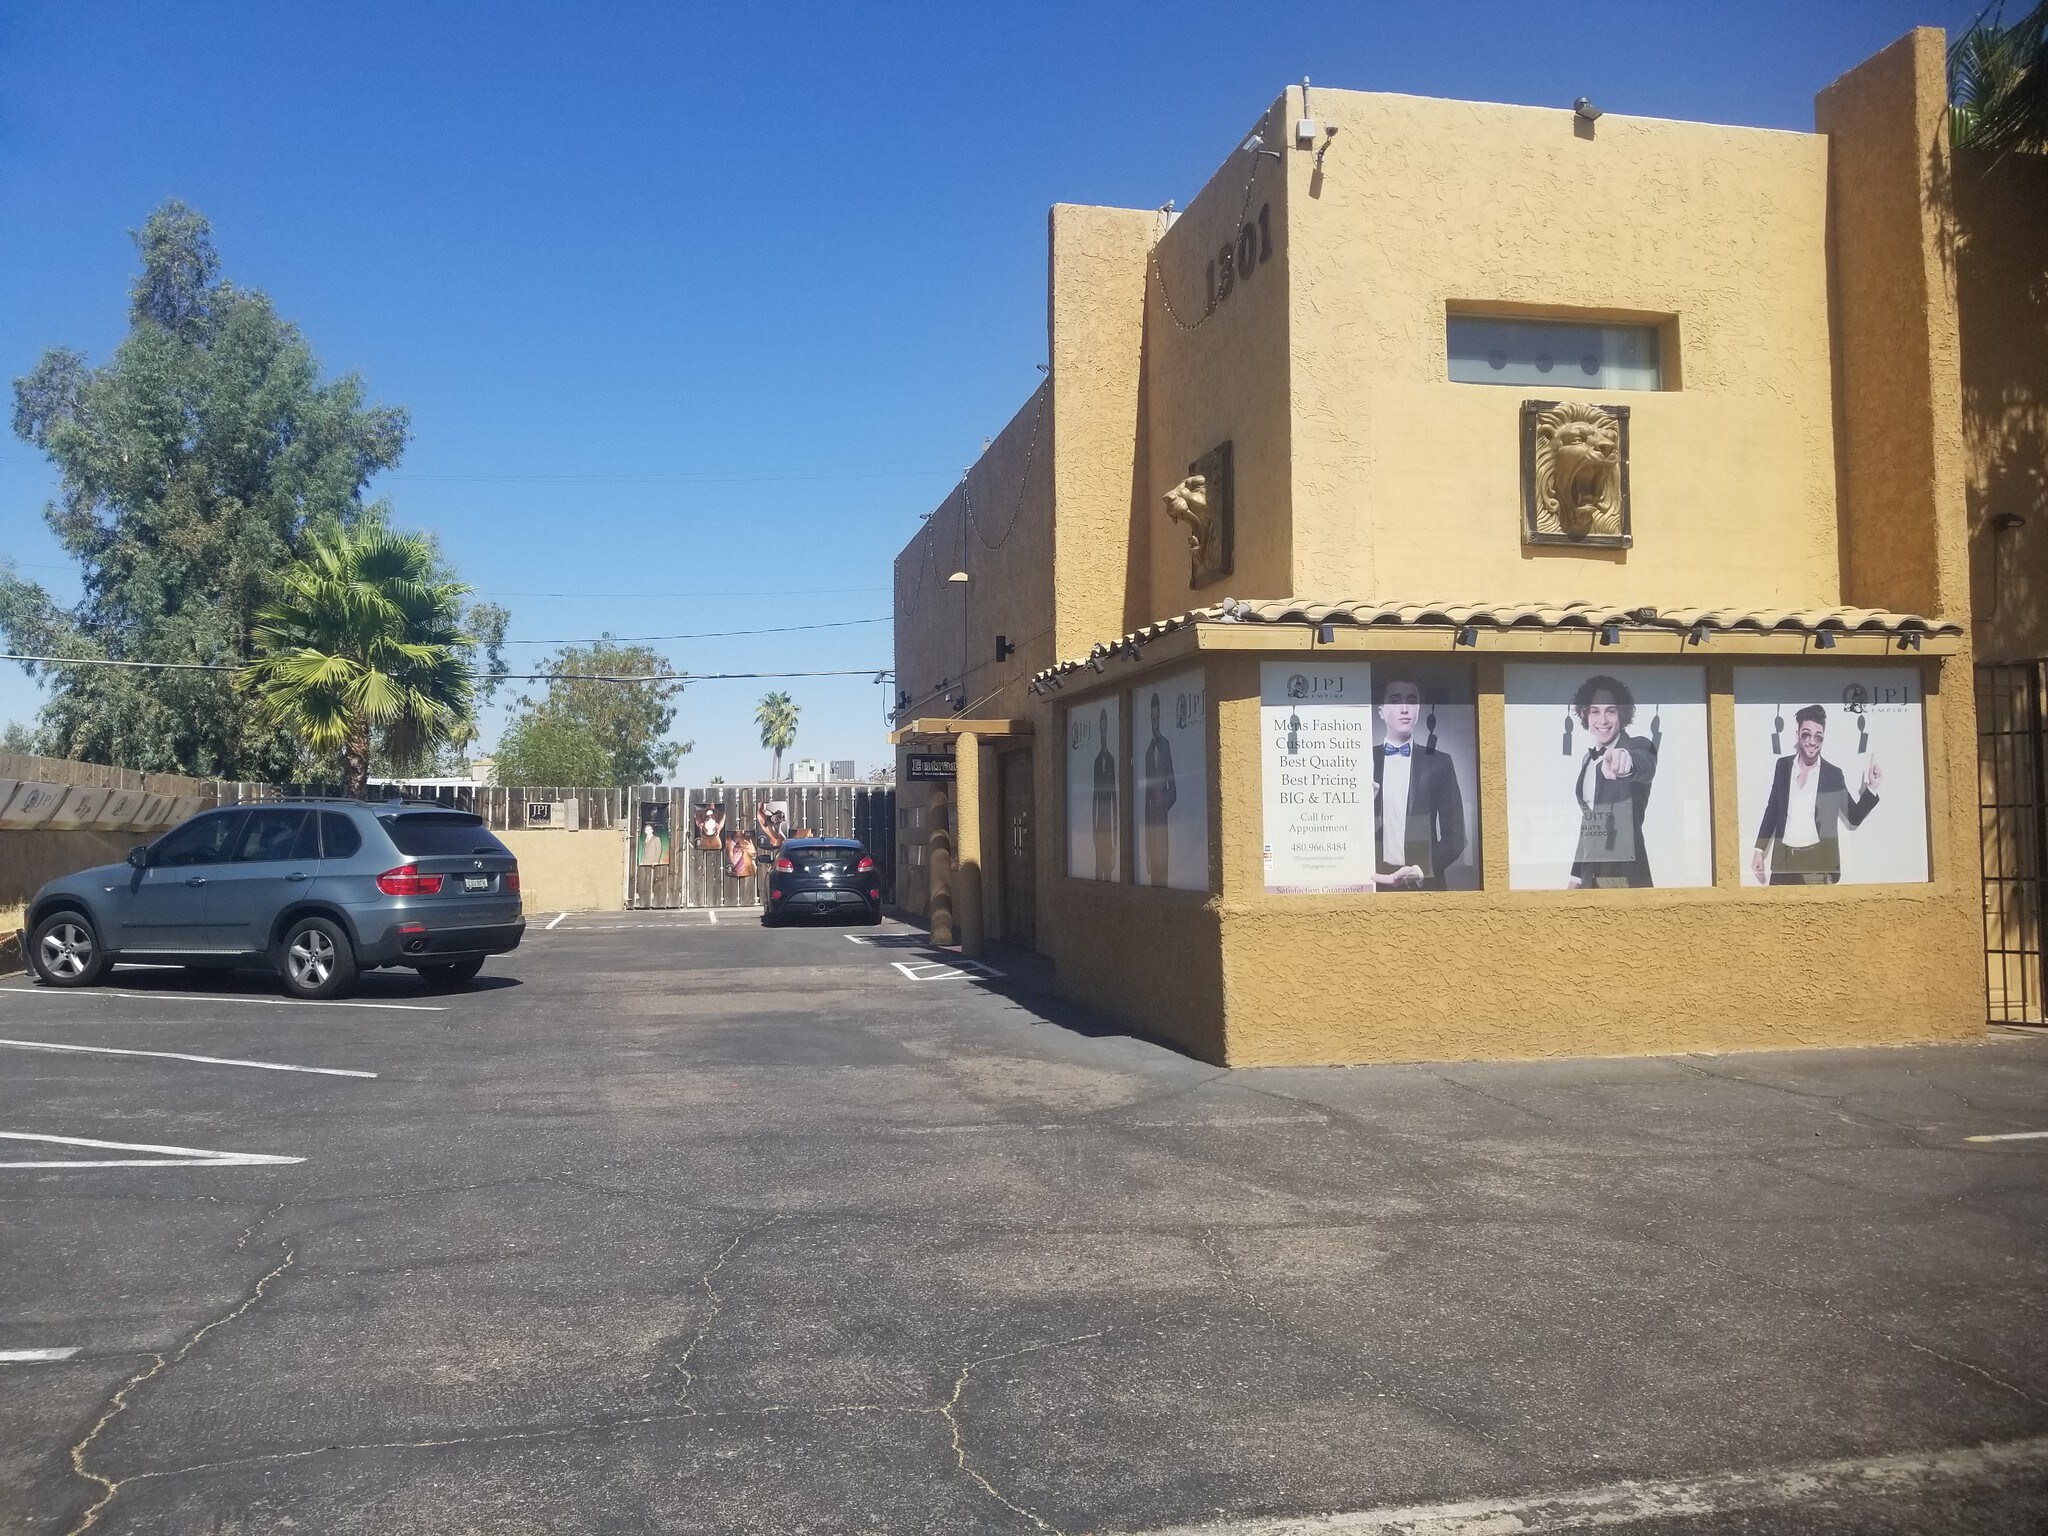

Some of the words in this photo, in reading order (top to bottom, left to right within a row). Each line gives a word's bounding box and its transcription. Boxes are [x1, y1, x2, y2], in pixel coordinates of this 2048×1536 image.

[1205, 202, 1273, 317] 1301
[1310, 676, 1343, 692] JPJ
[1871, 686, 1909, 706] JPJ
[1187, 690, 1205, 718] JPJ
[1273, 719, 1309, 731] Mens
[1313, 718, 1362, 731] Fashion
[1275, 737, 1326, 750] Custom
[1329, 737, 1361, 750] Suits
[1279, 756, 1307, 768] Best
[1309, 755, 1358, 770] Quality
[1281, 774, 1307, 786] Best
[1312, 773, 1357, 790] Pricing
[1279, 792, 1304, 804] BIG
[1308, 792, 1319, 804] &
[1322, 792, 1360, 804] TALL
[532, 804, 548, 817] JPJ
[1300, 813, 1318, 822] Call
[1320, 813, 1334, 822] for
[1289, 824, 1348, 835] Appointment
[1291, 843, 1346, 852] 480.966.8484
[1276, 886, 1320, 894] Satisfaction
